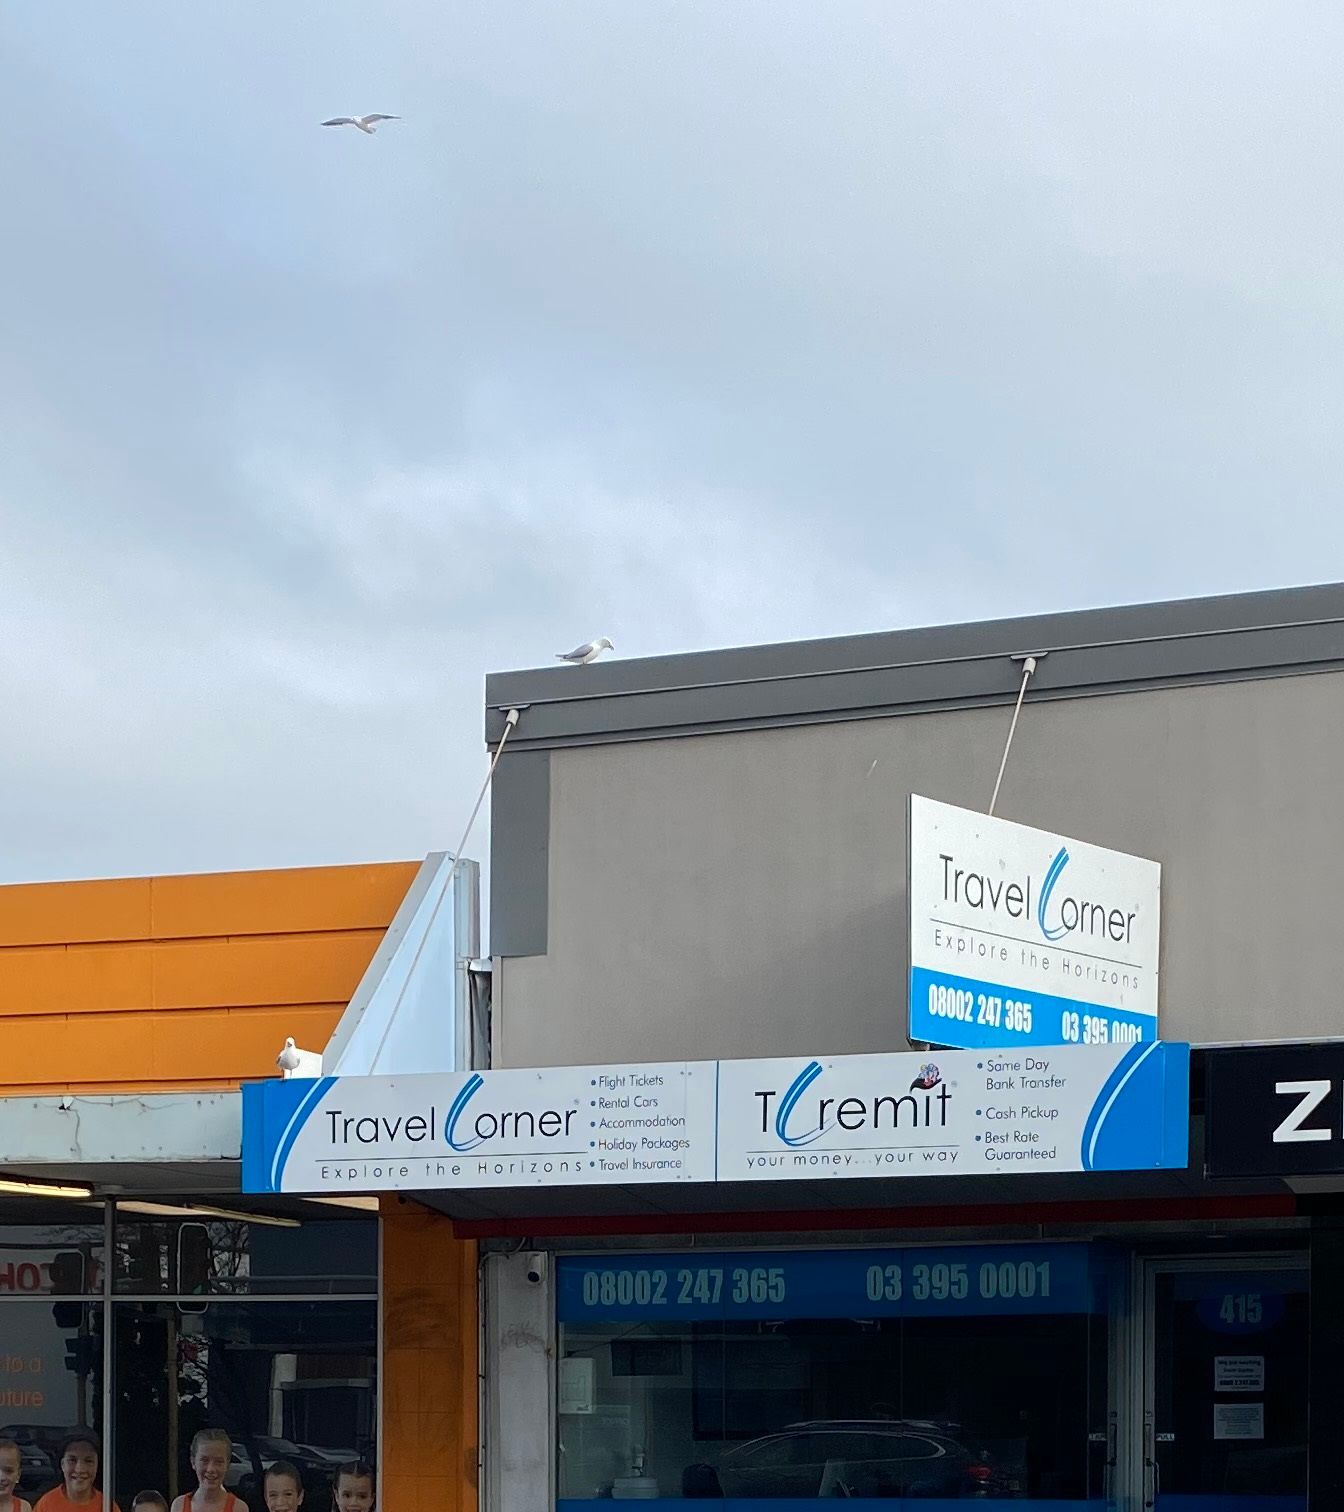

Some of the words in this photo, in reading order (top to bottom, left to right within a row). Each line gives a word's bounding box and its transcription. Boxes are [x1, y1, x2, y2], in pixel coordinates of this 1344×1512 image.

[939, 854, 1031, 920] Travel
[1038, 846, 1136, 943] Corner
[935, 929, 1007, 961] Explore
[1022, 950, 1049, 970] the
[1062, 961, 1138, 989] Horizons
[928, 983, 973, 1023] 08002
[977, 992, 1003, 1028] 247
[1005, 1000, 1033, 1034] 365
[1061, 1011, 1080, 1043] 03
[1083, 1014, 1108, 1044] 395
[987, 1060, 1021, 1072] Same
[1025, 1058, 1050, 1073] Day
[599, 1075, 626, 1090] Flight
[629, 1074, 664, 1087] Tickets
[986, 1077, 1015, 1090] Bank
[1020, 1075, 1067, 1089] Transfer
[599, 1096, 630, 1109] Rental
[633, 1095, 658, 1108] Cars
[326, 1106, 435, 1144] Travel
[444, 1073, 577, 1152] Corner
[986, 1106, 1016, 1120] Cash
[1021, 1106, 1059, 1120] Pickup
[599, 1115, 686, 1129] Accommodation
[598, 1137, 638, 1152] Holiday
[641, 1136, 690, 1151] Packages
[985, 1131, 1009, 1144] Best
[1014, 1130, 1039, 1143] Rate
[747, 1155, 785, 1169] your
[923, 1150, 959, 1163] way
[985, 1146, 1057, 1160] Guaranteed
[321, 1164, 409, 1180] Explore
[425, 1163, 461, 1176] the
[478, 1160, 582, 1175] Horizons
[598, 1158, 629, 1170] Travel
[632, 1158, 682, 1169] Insurance
[583, 1270, 668, 1306] 08002
[678, 1268, 723, 1305] 247
[732, 1267, 785, 1303] 365
[866, 1264, 903, 1301] 03
[913, 1262, 969, 1300] 395
[979, 1261, 1051, 1298] 0001
[1219, 1294, 1263, 1324] 415
[8, 1353, 25, 1374] to
[30, 1357, 42, 1374] a
